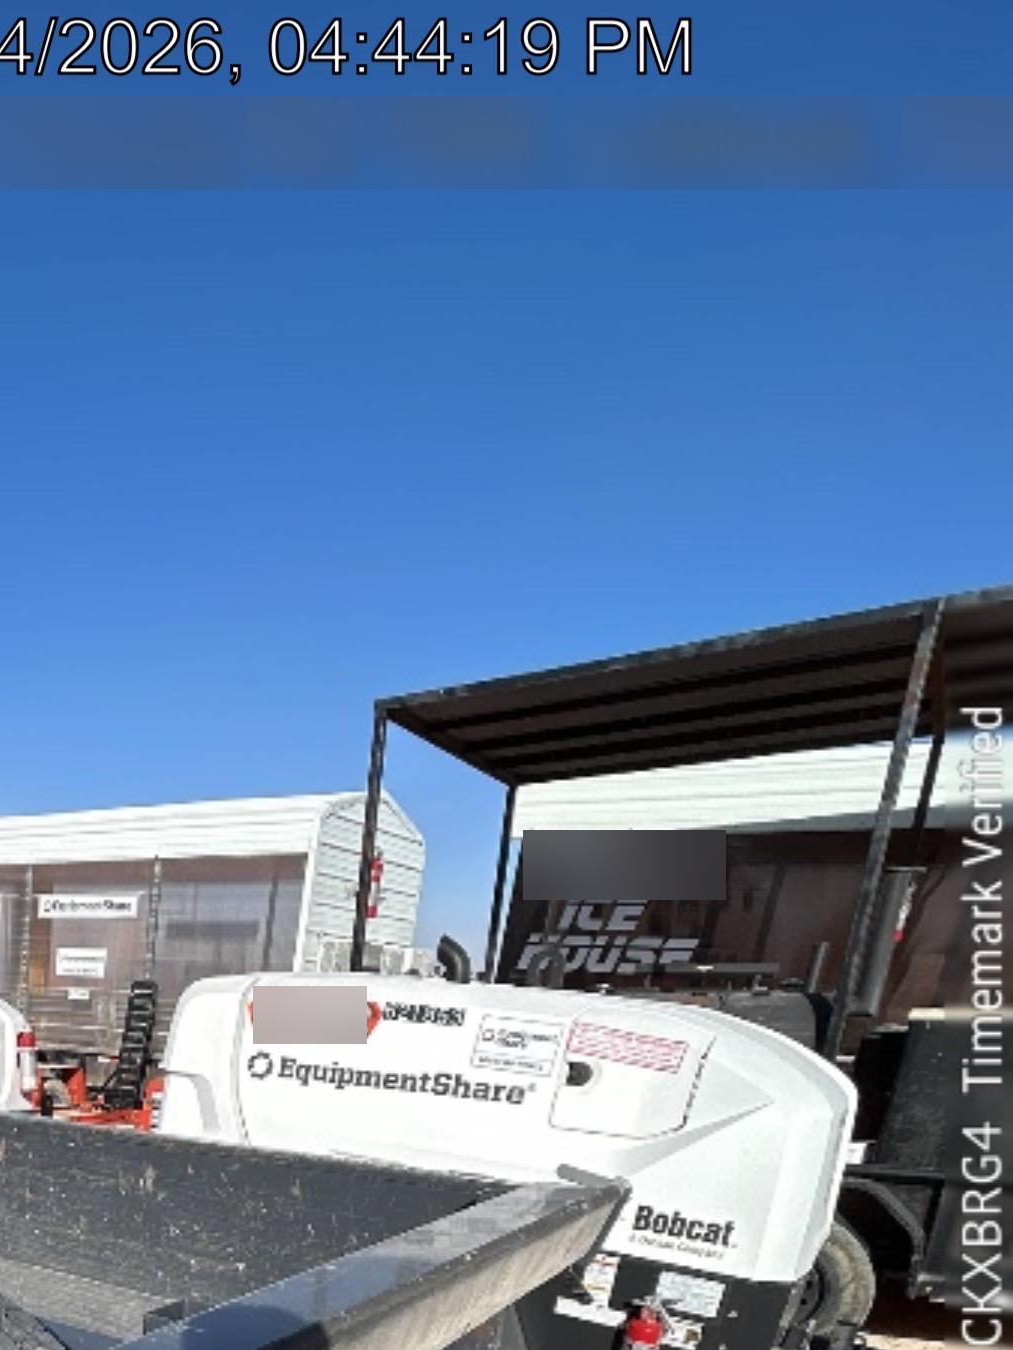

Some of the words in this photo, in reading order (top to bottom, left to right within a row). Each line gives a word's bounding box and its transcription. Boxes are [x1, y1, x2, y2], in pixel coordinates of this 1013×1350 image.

[557, 899, 647, 931] ICE
[517, 932, 700, 973] HOUSE
[277, 1056, 526, 1104] EquipmentShare
[632, 1205, 736, 1246] Bobcat
